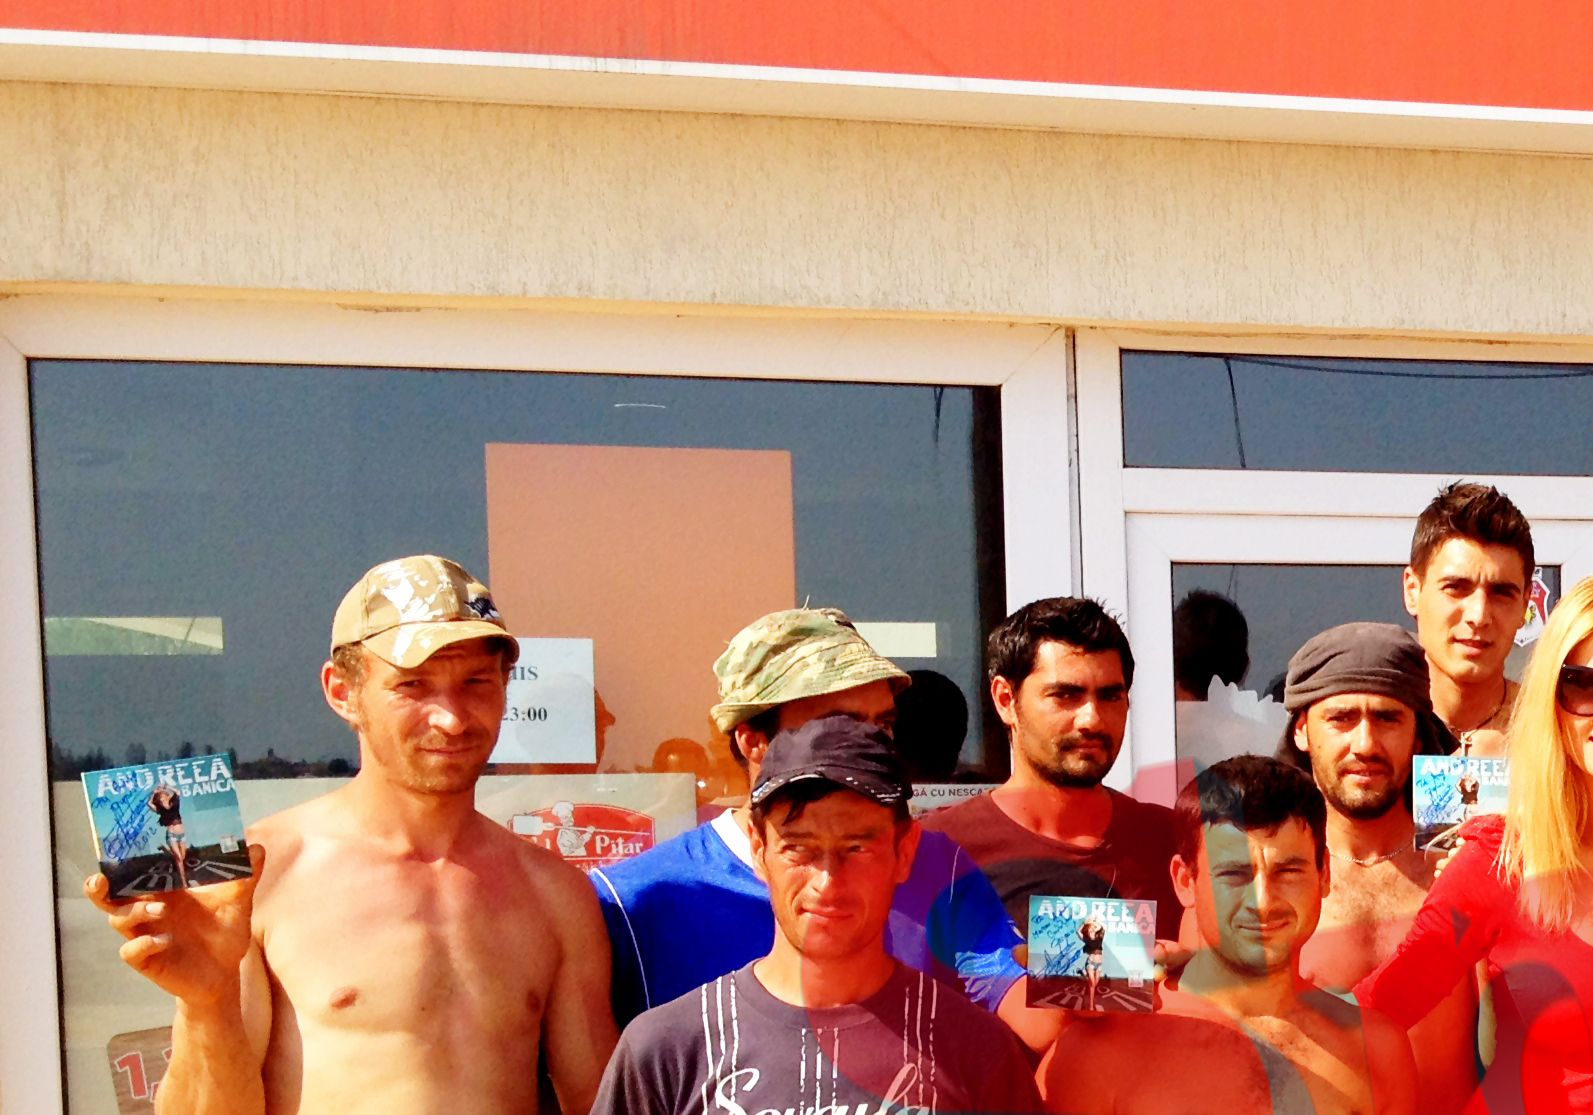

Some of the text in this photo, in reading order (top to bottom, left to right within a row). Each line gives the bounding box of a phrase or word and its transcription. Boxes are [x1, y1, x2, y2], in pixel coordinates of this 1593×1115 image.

[503, 706, 548, 722] 3:00
[97, 757, 232, 797] ANDREEA
[931, 788, 945, 797] CU
[1038, 899, 1155, 923] ANDREEA
